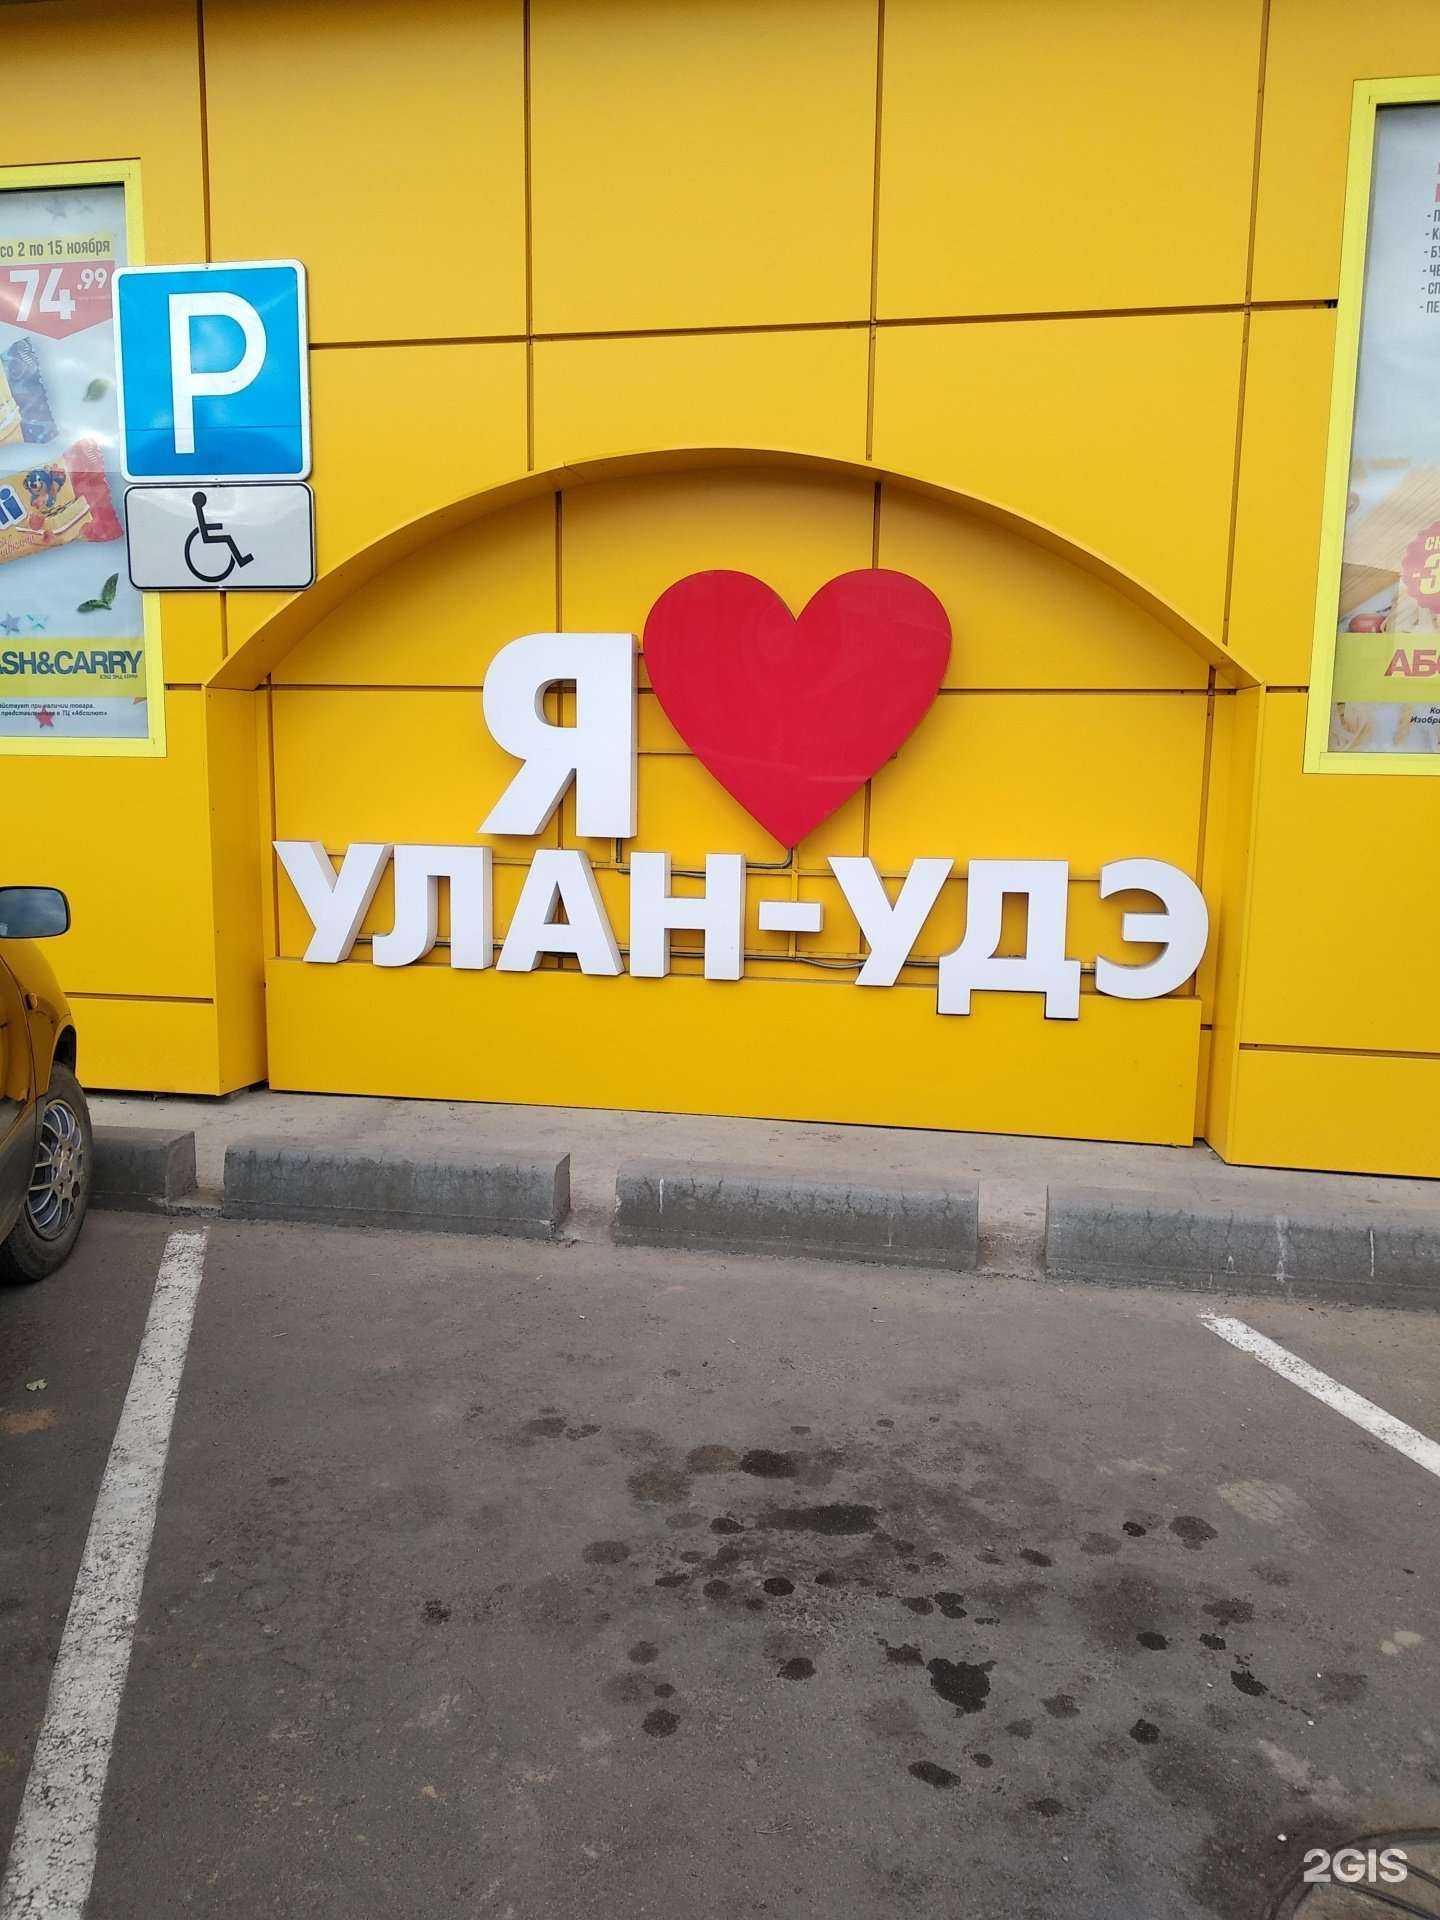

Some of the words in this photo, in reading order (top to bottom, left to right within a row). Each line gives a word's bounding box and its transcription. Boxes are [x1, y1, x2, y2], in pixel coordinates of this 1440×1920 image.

[0, 246, 13, 257] со
[17, 242, 25, 257] 2
[30, 243, 44, 256] по
[48, 240, 62, 255] 15
[67, 239, 110, 256] ноября
[169, 291, 267, 454] P
[0, 650, 142, 675] SH&CARRY
[1384, 648, 1440, 676] АБ
[478, 632, 638, 839] Я
[273, 841, 1209, 1019] УЛАН-УДЭ
